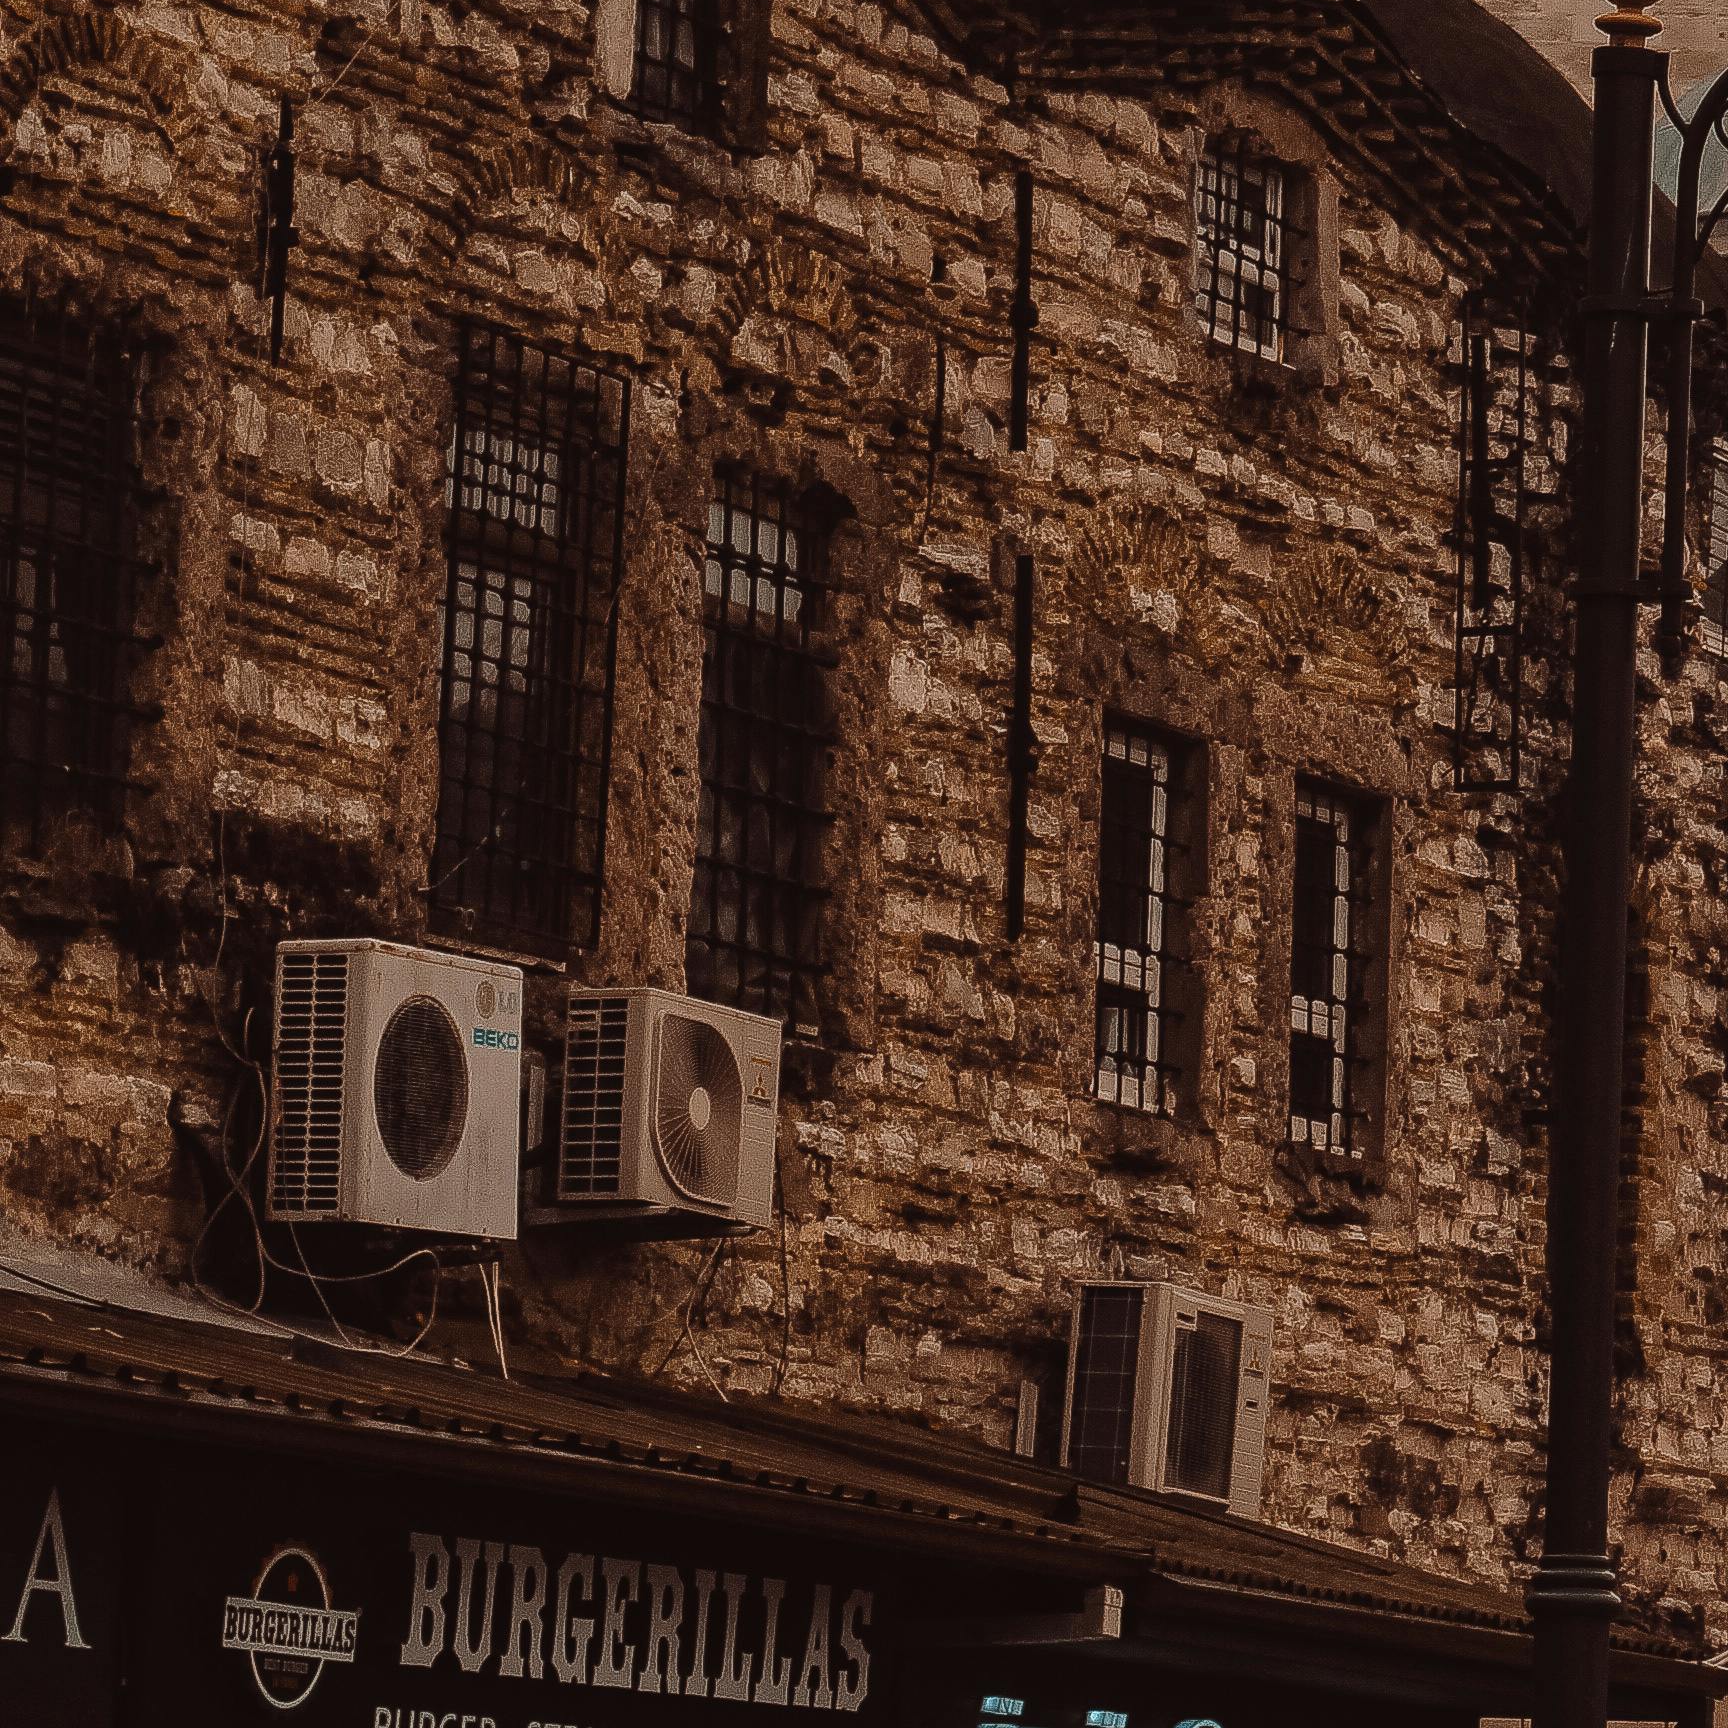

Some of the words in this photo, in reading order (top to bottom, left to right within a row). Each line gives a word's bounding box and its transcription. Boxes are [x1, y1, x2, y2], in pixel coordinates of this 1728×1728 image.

[473, 1027, 519, 1049] BEKO
[225, 1604, 357, 1654] BURGERILLAS
[400, 1531, 873, 1712] BURGERILLAS
